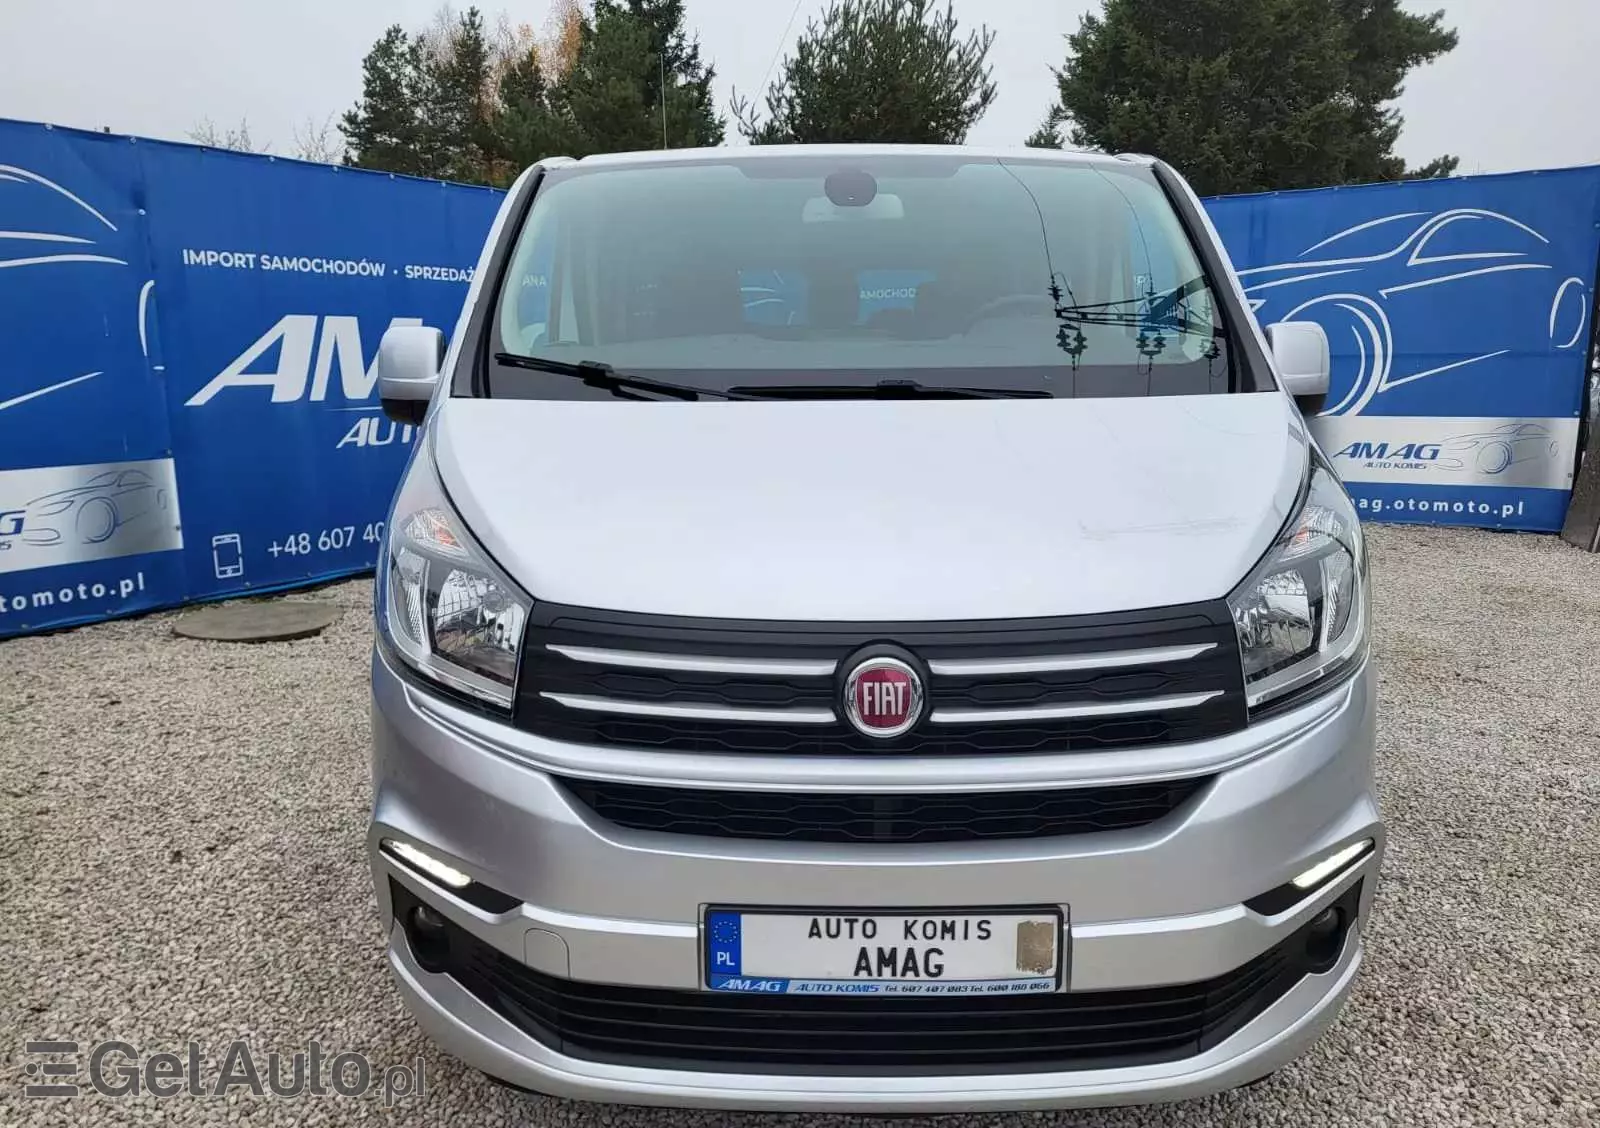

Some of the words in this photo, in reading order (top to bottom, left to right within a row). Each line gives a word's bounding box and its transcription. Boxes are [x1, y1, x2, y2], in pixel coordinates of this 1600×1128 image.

[182, 248, 257, 269] IMPORT
[260, 254, 386, 277] SAMOCHODÓW
[1351, 498, 1524, 519] ag.otomoto.pl
[267, 533, 311, 558] +48
[318, 526, 355, 551] 607
[863, 681, 907, 716] FIAT
[808, 918, 877, 940] AUTO
[903, 919, 992, 941] KOMIS
[716, 951, 735, 967] PL
[853, 946, 945, 977] AMAG
[718, 979, 783, 992] AMAG
[795, 983, 833, 993] AUTO
[835, 983, 881, 993] KOMIS
